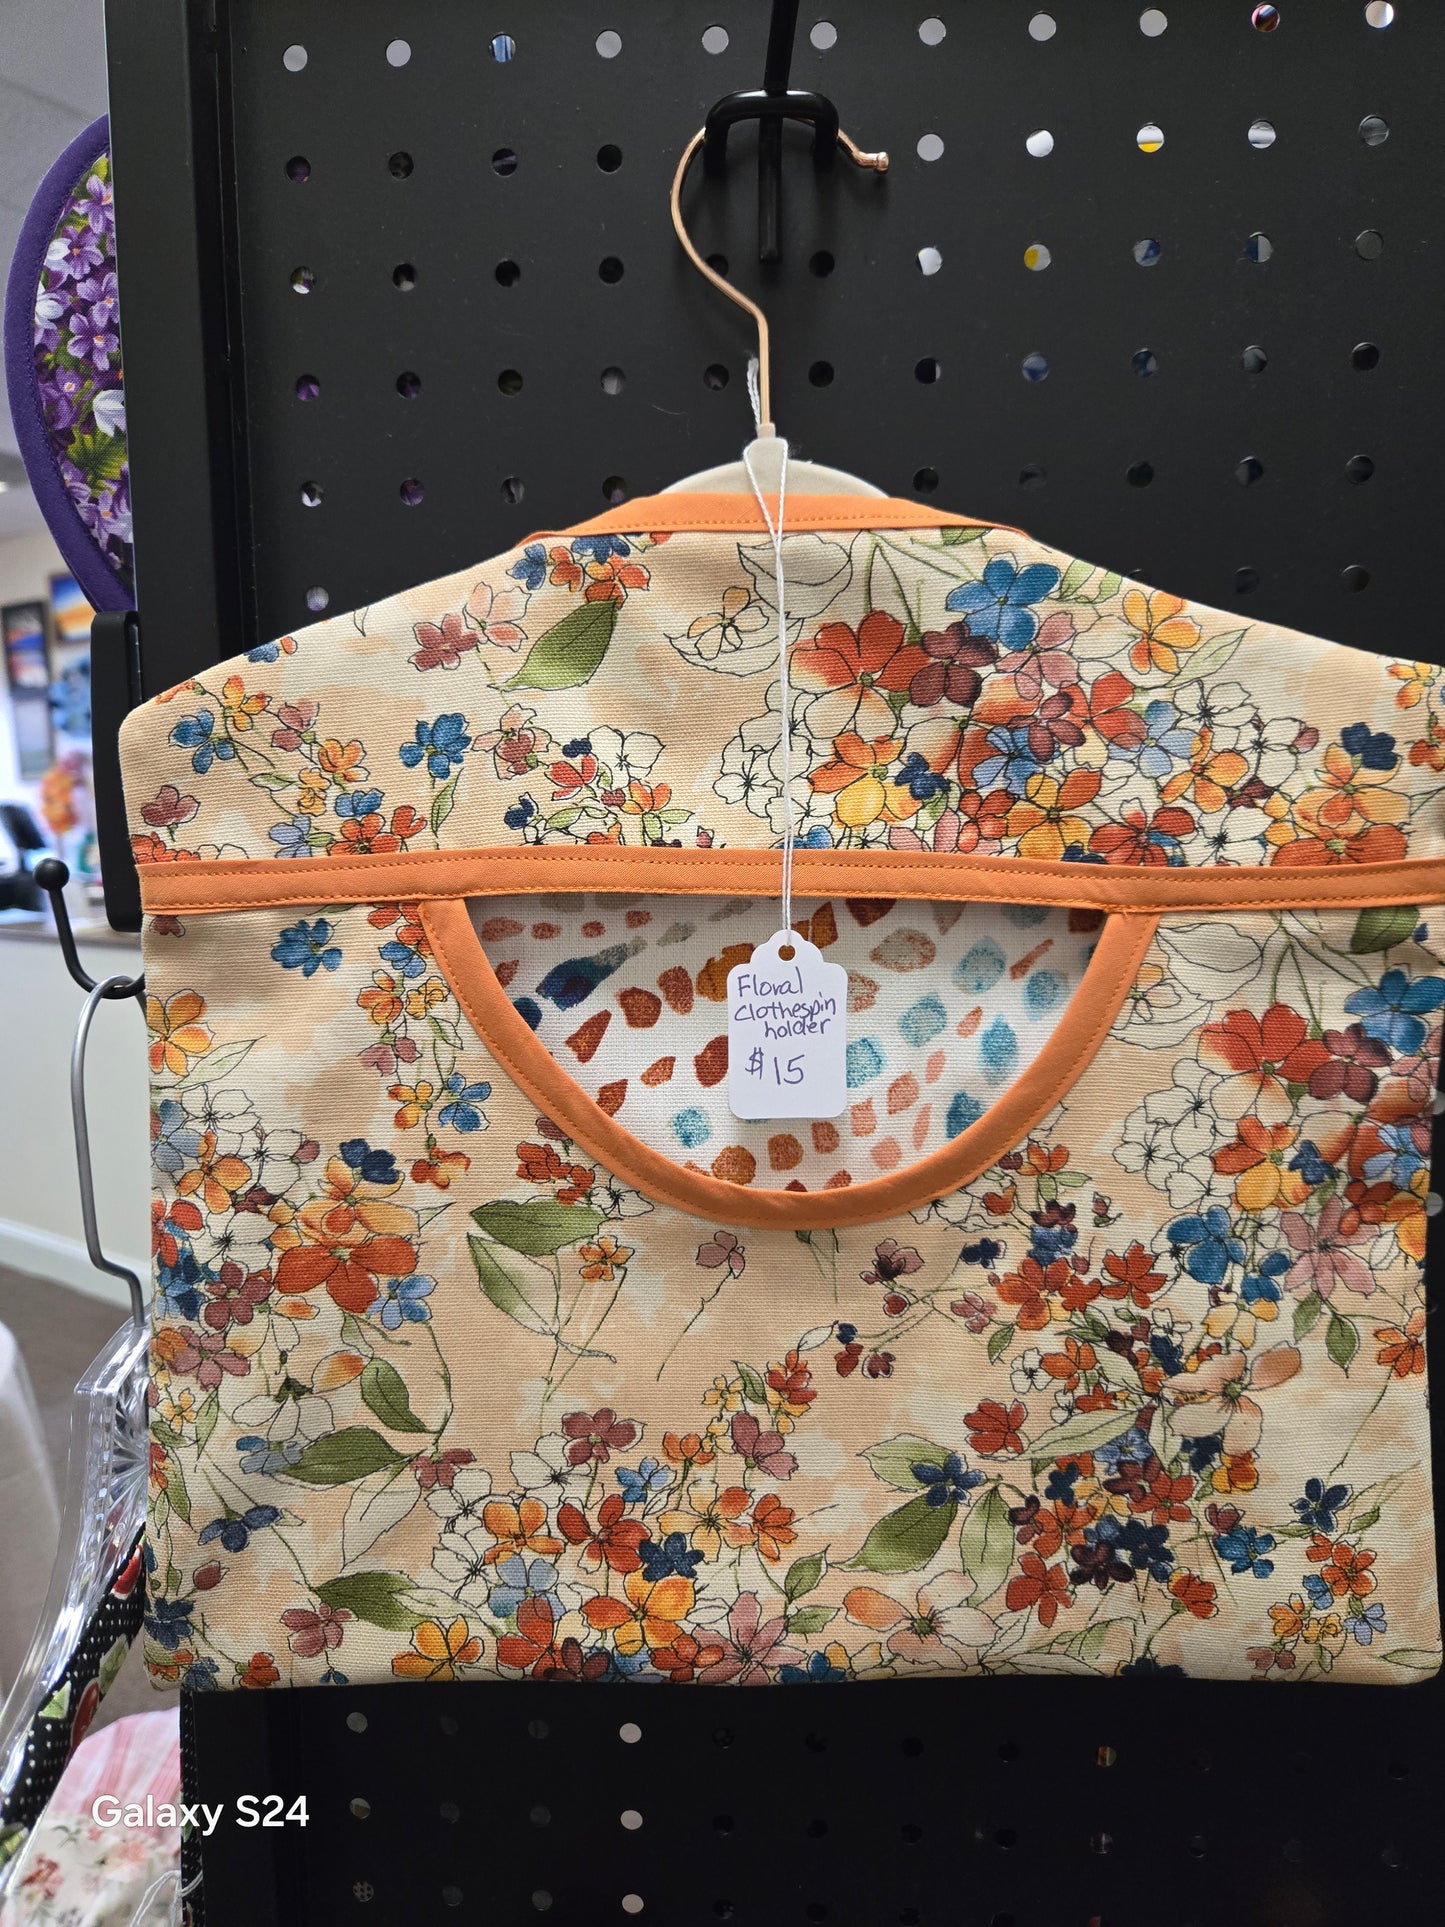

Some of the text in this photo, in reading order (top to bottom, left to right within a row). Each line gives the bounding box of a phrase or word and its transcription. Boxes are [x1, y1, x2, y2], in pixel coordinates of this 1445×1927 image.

[737, 966, 803, 997] Floral
[764, 1018, 831, 1039] holder
[745, 1047, 805, 1085] $15
